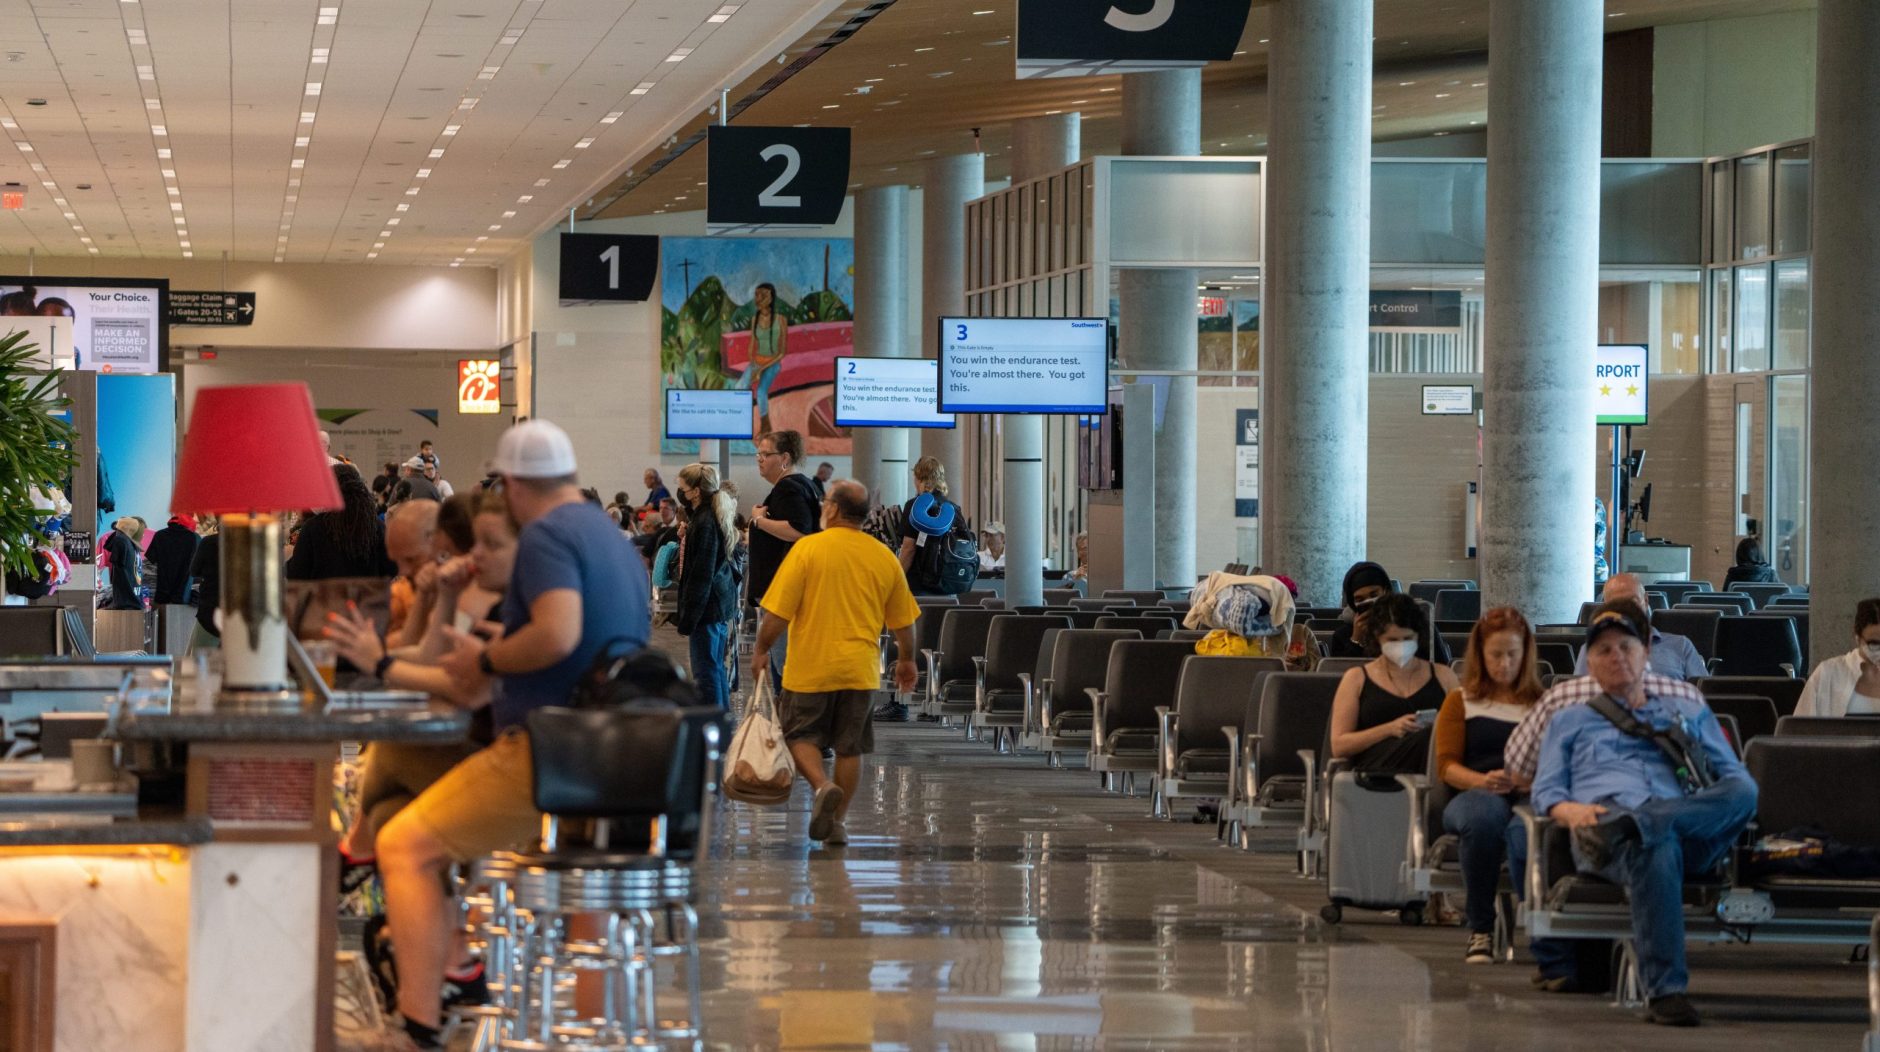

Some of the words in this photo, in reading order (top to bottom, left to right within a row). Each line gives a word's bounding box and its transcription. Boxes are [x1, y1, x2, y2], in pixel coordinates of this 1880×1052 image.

[758, 144, 801, 207] 2
[599, 245, 620, 289] 1
[88, 292, 111, 301] Your
[114, 292, 150, 302] Choice.
[1202, 298, 1224, 315] EXIT
[1370, 304, 1378, 312] rt
[1380, 304, 1419, 312] Control
[957, 324, 968, 341] 3
[94, 337, 148, 345] INFORMED
[94, 345, 145, 354] DECISION.
[950, 356, 968, 364] You
[970, 356, 986, 364] win
[990, 356, 1006, 364] the
[1008, 356, 1058, 365] endurance
[1060, 357, 1080, 365] test.
[848, 362, 856, 374] 2
[1596, 365, 1640, 378] RPORT
[950, 370, 980, 378] You're
[982, 370, 1014, 378] almost
[1016, 370, 1044, 378] there.
[1048, 370, 1067, 379] You
[1069, 372, 1085, 381] got
[950, 383, 970, 392] this.
[676, 392, 681, 402] 1
